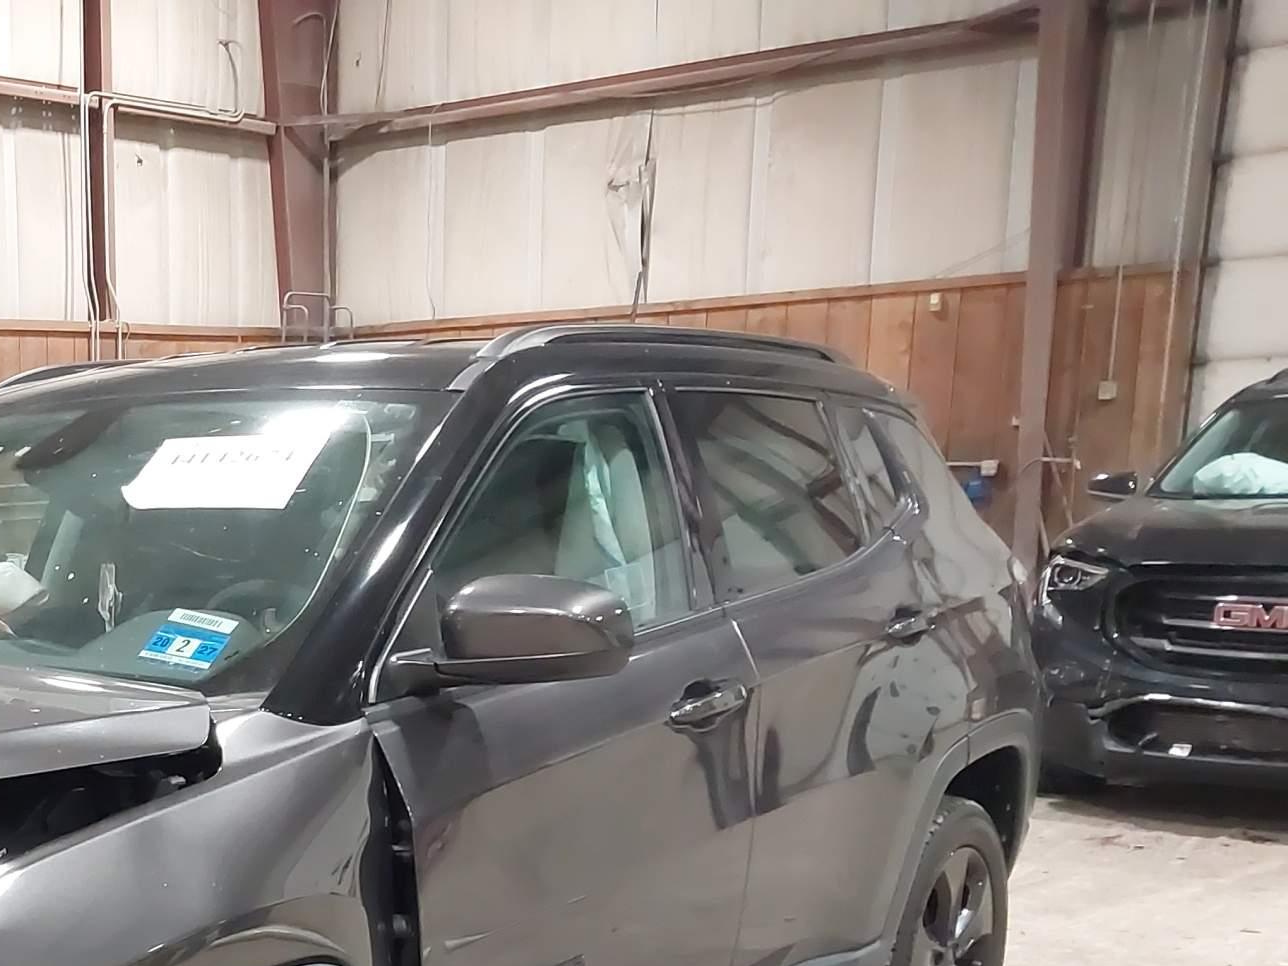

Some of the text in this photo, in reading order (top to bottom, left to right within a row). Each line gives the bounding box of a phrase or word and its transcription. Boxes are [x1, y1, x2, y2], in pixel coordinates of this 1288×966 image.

[152, 636, 218, 656] 20 2 27
